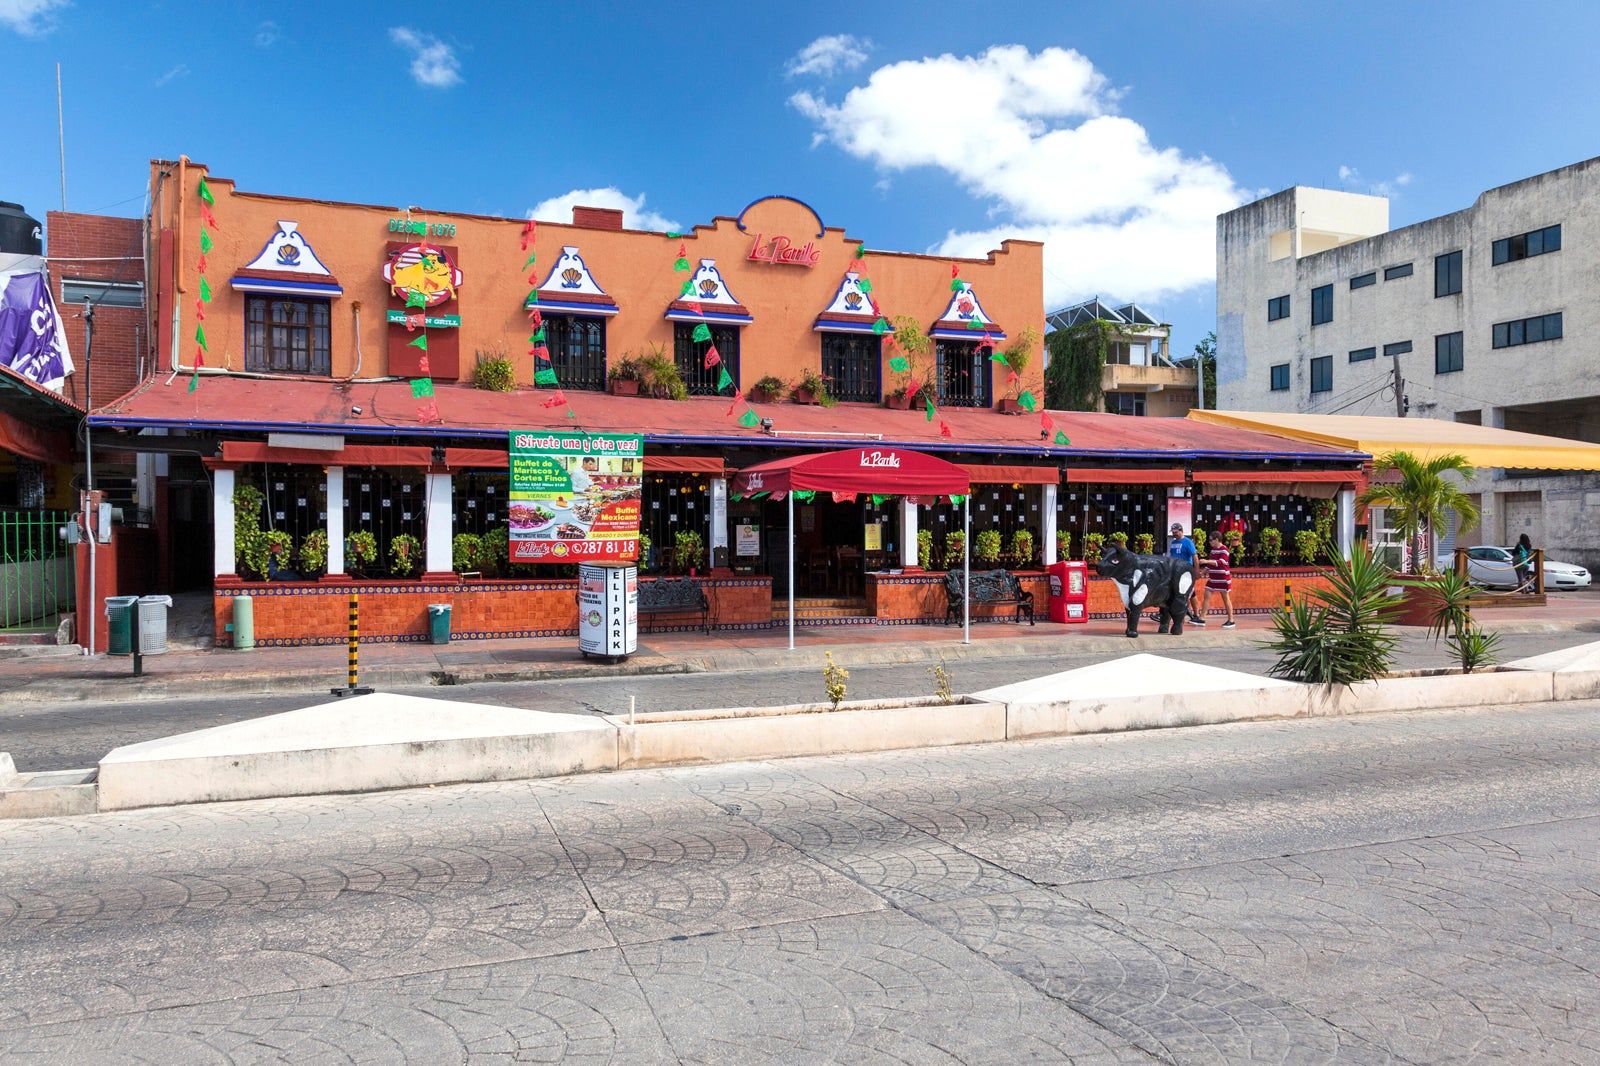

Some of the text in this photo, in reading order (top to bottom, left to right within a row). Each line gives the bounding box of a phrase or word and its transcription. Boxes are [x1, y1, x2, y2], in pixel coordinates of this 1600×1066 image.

[390, 218, 456, 238] DES 1975
[769, 236, 821, 267] Parrilla
[562, 439, 581, 449] una
[582, 439, 591, 452] y
[593, 438, 614, 450] otra
[618, 440, 639, 451] vez!
[870, 452, 900, 468] Parrilla
[582, 541, 635, 553] 287 81 18
